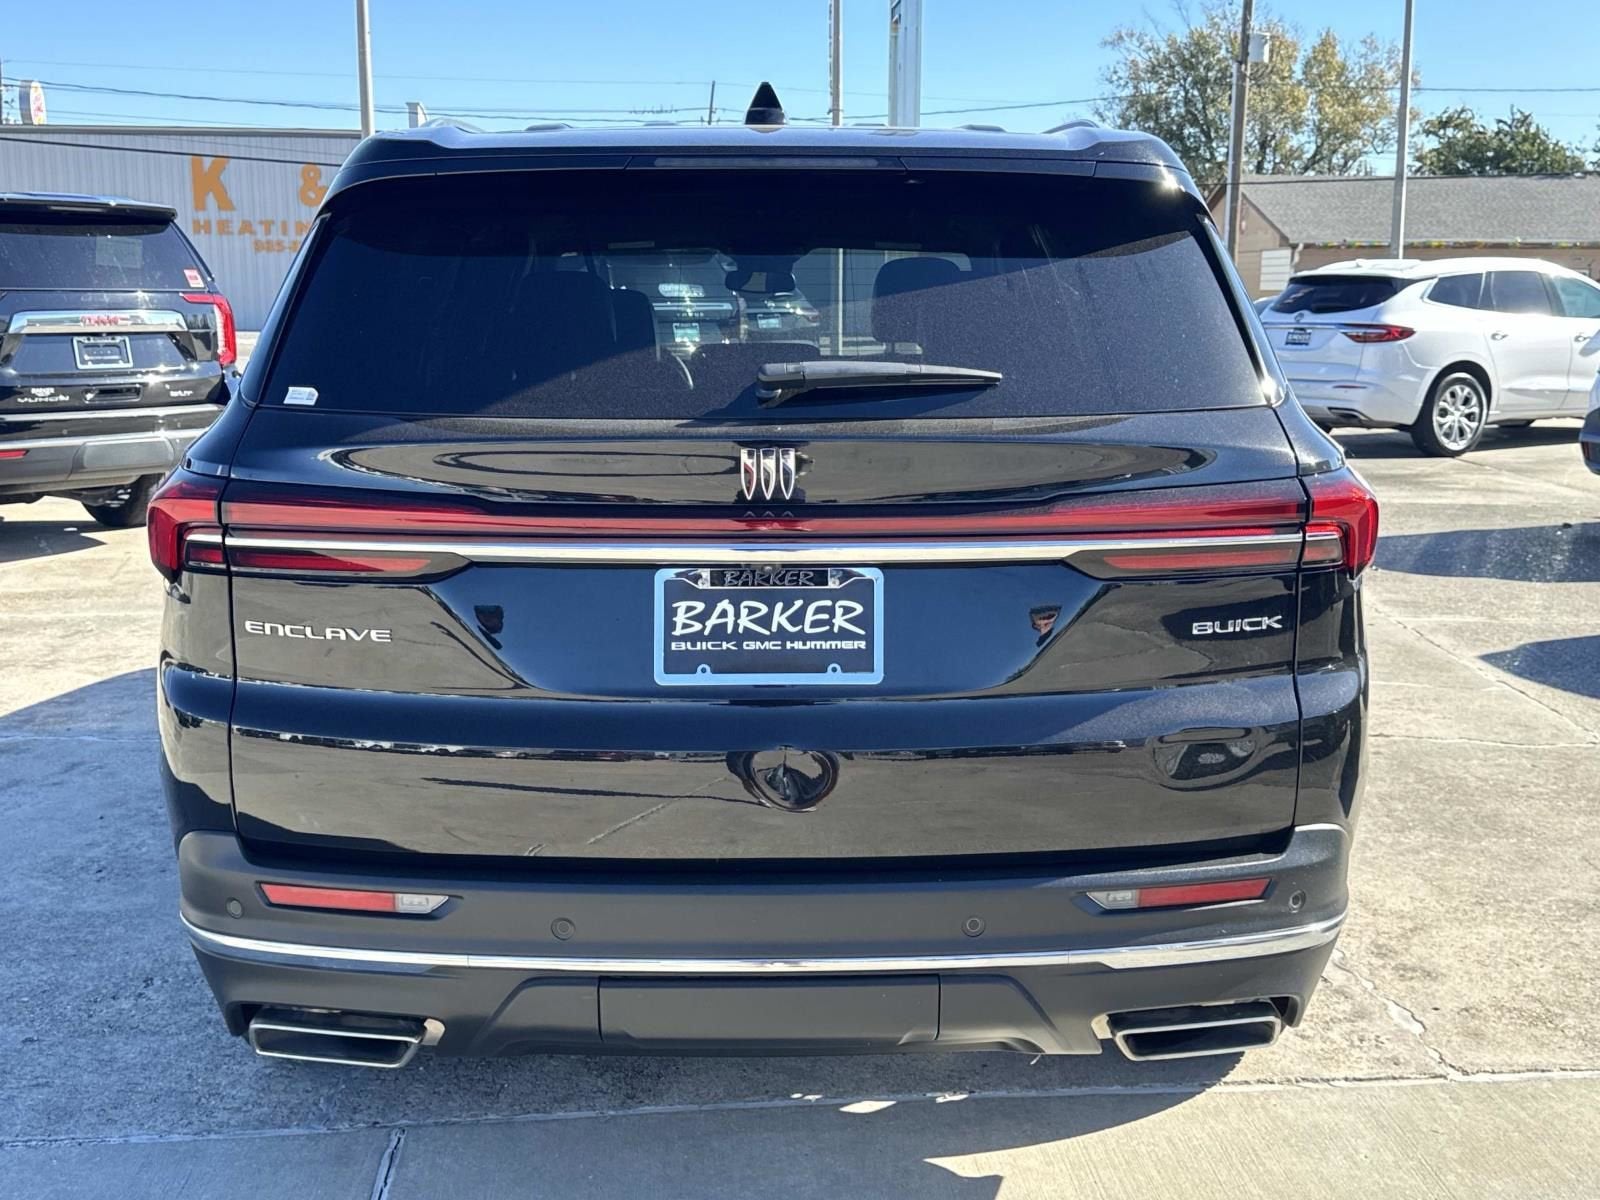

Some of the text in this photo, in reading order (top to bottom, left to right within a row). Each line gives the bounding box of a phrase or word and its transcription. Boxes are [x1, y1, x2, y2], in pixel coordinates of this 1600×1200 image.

[190, 155, 328, 212] K &
[723, 569, 816, 587] BARKER
[671, 599, 866, 636] BARKER
[1191, 615, 1283, 635] BUICK
[244, 620, 392, 642] ENCLAVE
[671, 640, 866, 650] BUICK GMC HUMMER
